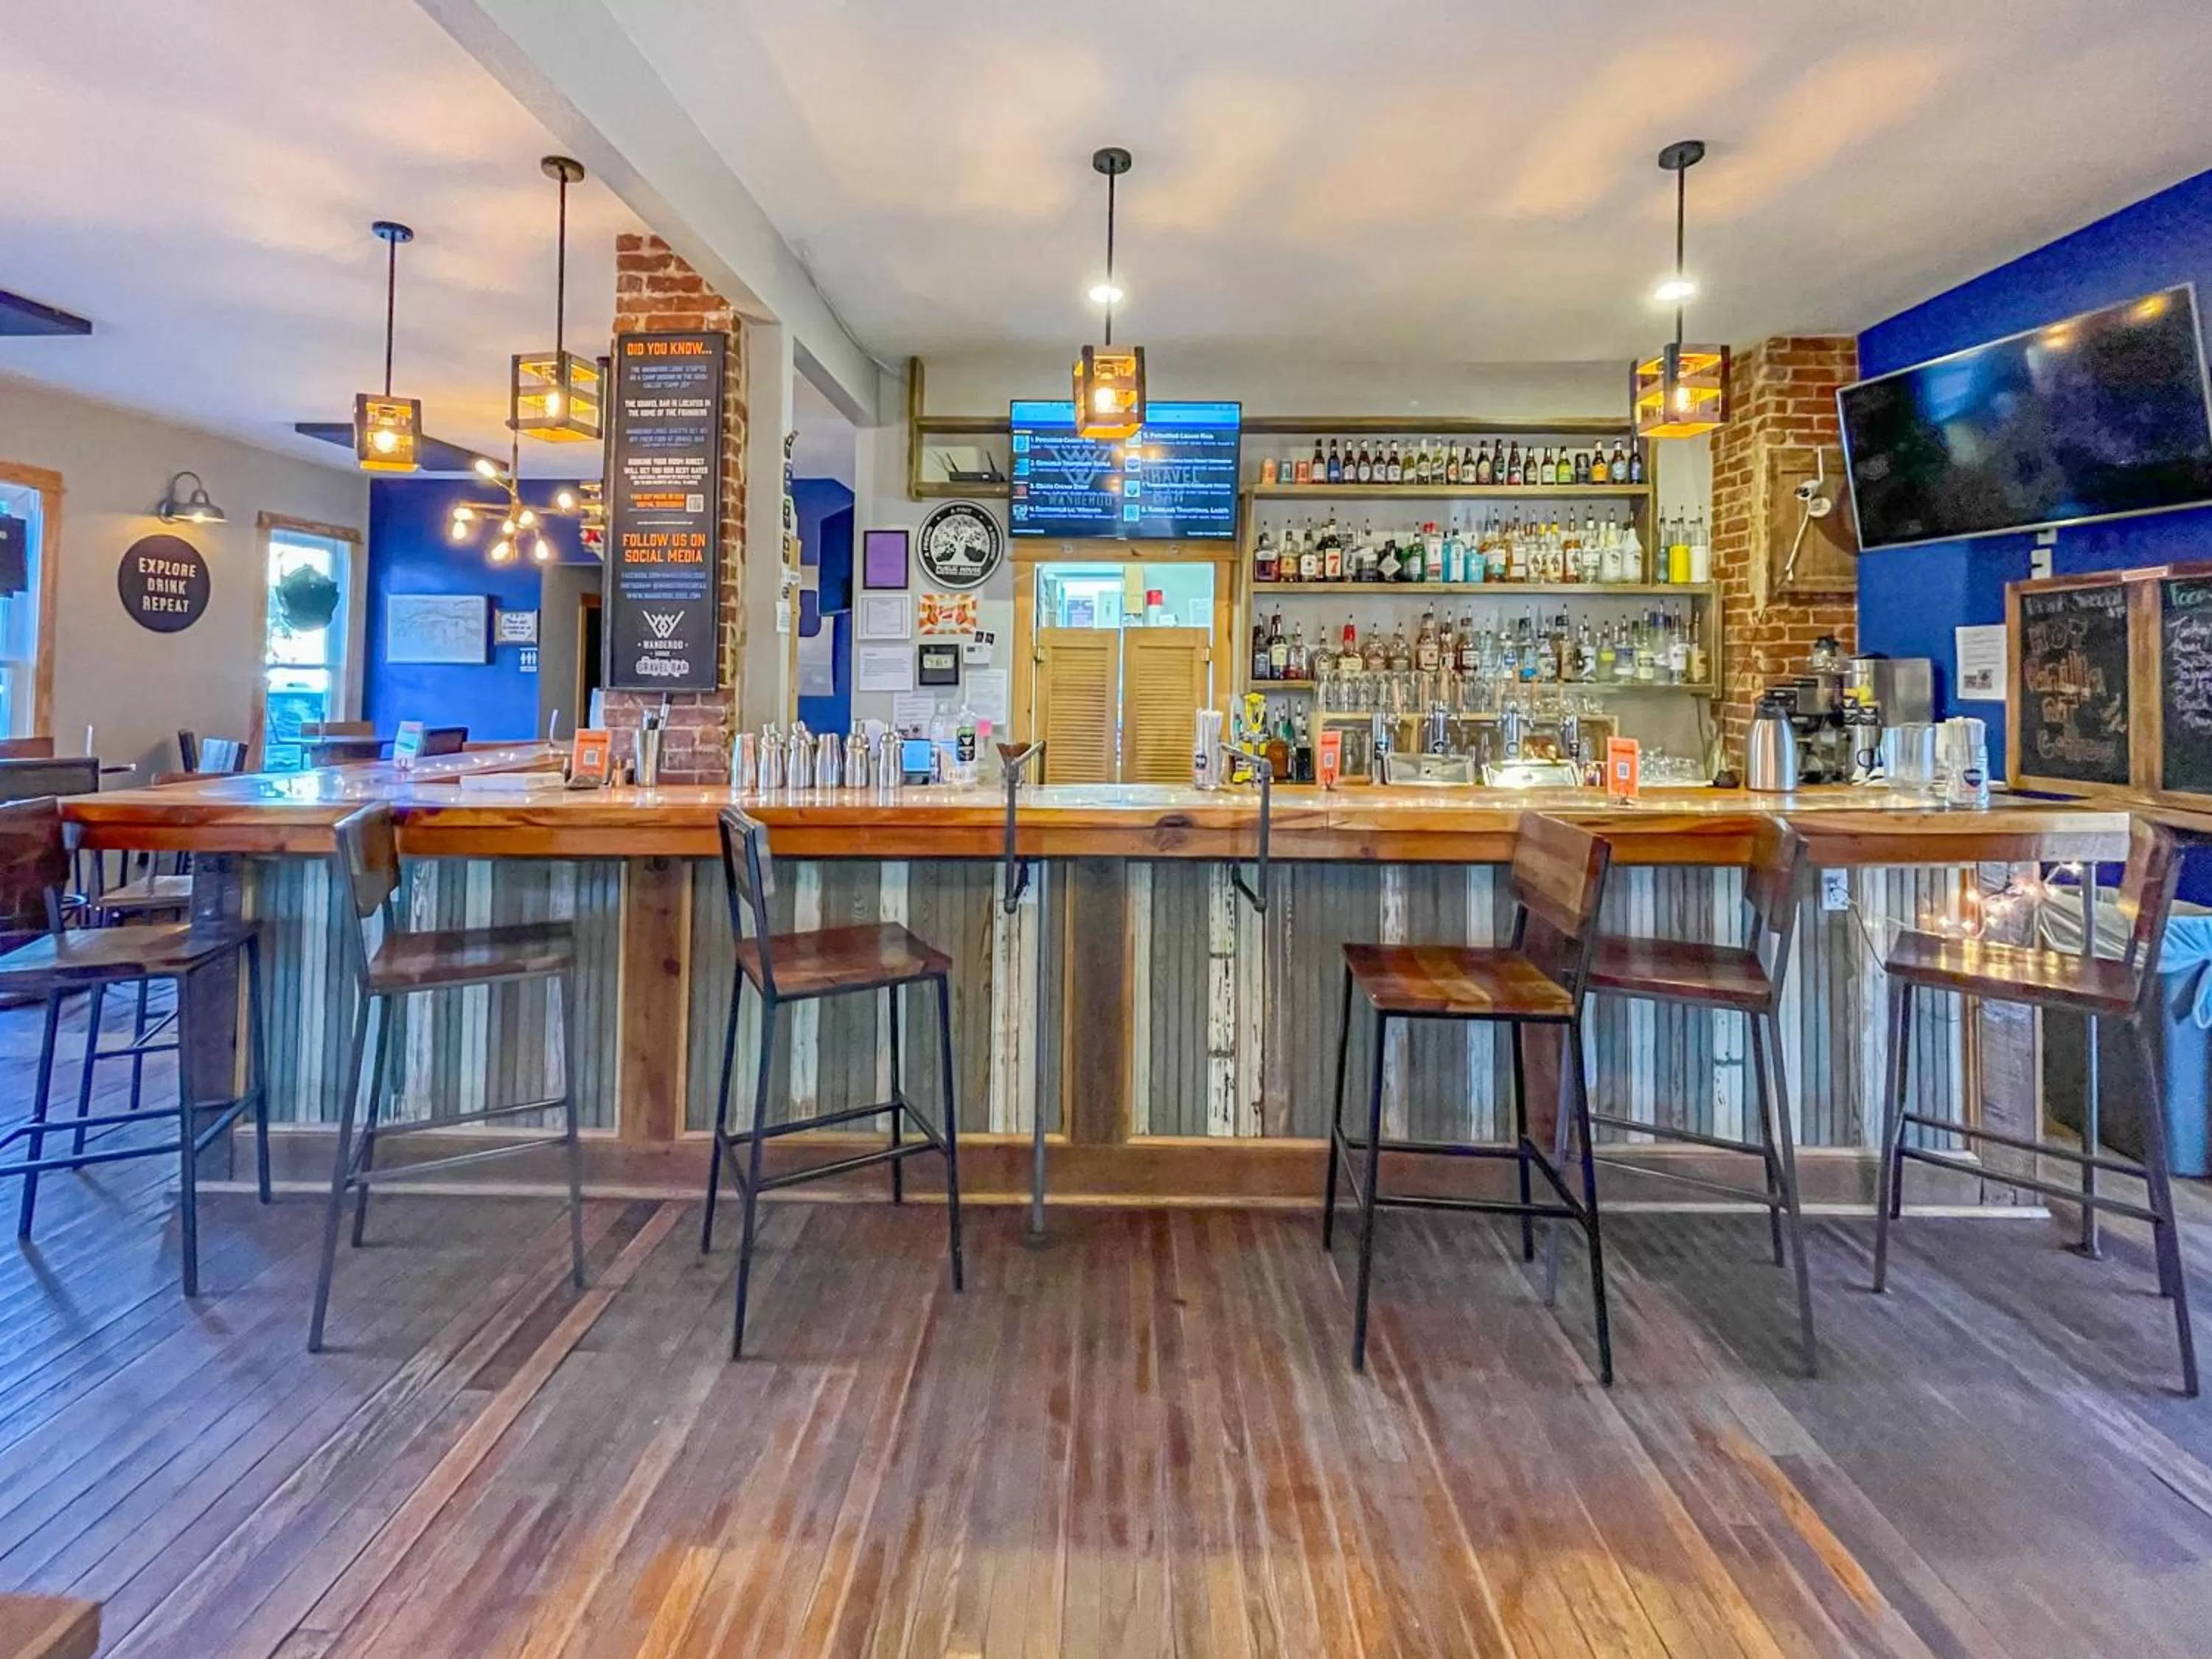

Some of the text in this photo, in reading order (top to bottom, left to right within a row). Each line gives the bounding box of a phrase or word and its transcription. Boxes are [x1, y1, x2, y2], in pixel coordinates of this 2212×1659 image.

[627, 342, 644, 355] DID
[647, 342, 667, 355] YOU
[623, 533, 706, 546] FOLLOW US ON
[625, 549, 703, 563] SOCIAL MEDIA
[138, 557, 198, 577] EXPLORE
[147, 577, 187, 594] DRINK
[142, 595, 189, 613] REPEAT
